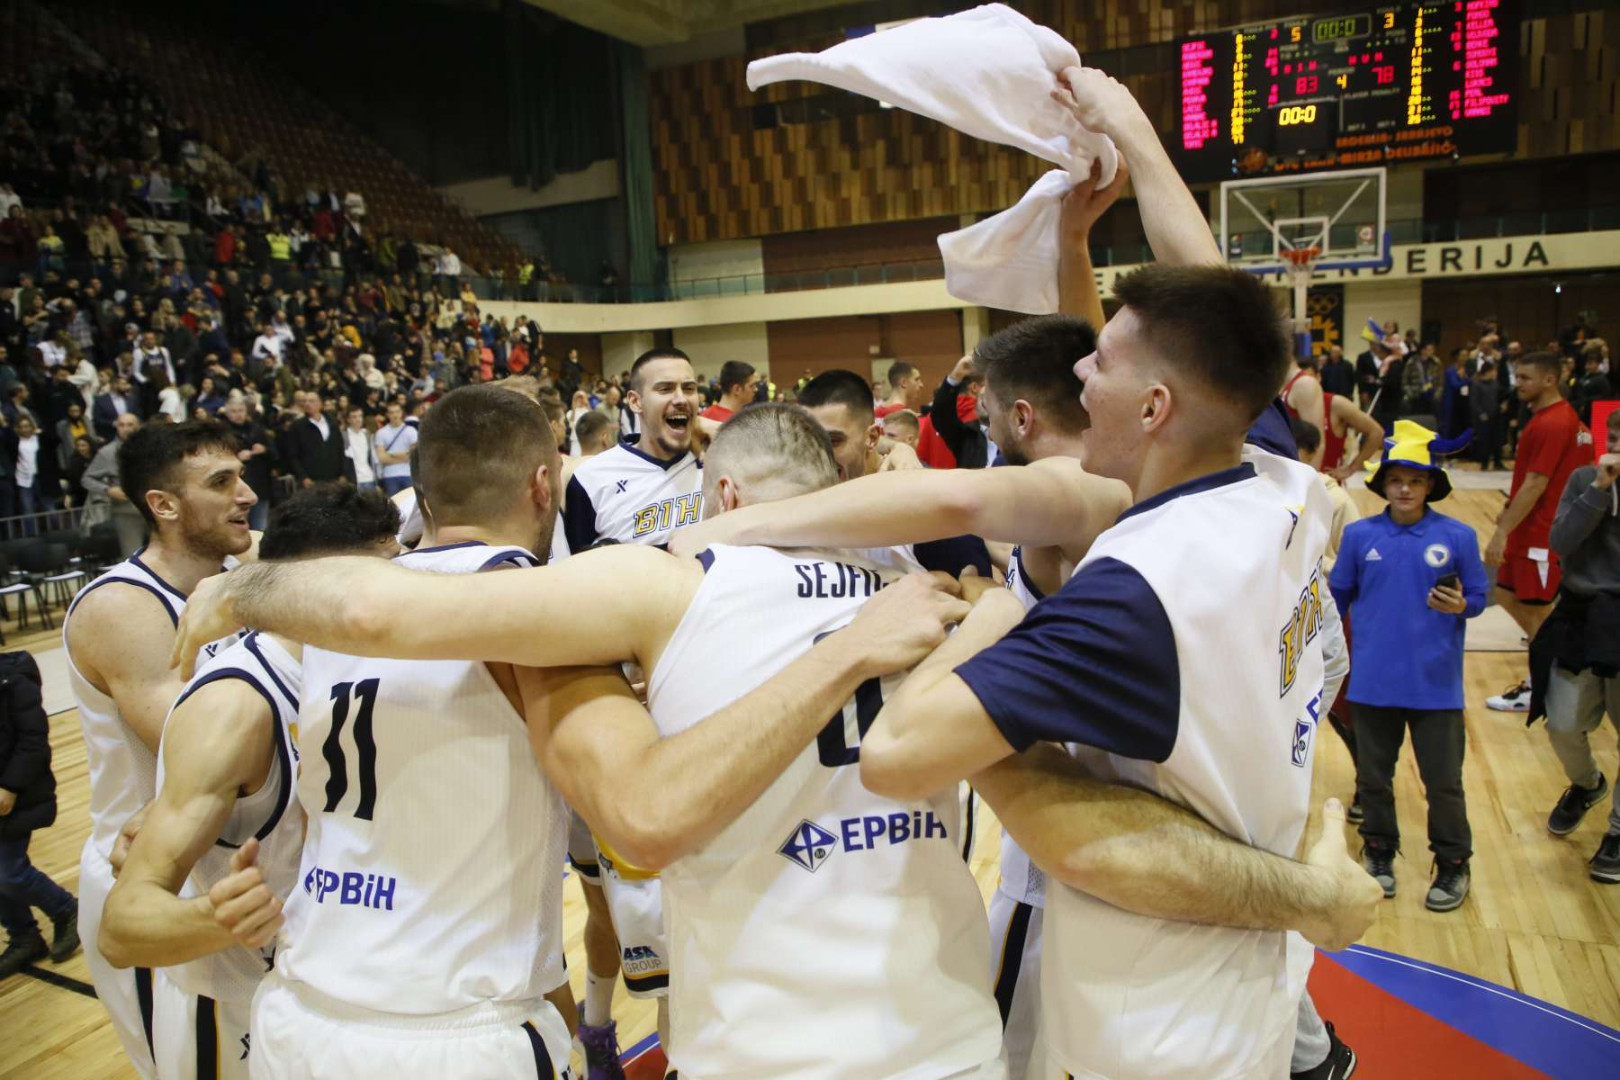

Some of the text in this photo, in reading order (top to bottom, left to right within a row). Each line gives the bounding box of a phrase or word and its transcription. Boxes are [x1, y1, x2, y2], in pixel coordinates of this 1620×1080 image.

[1317, 18, 1355, 40] 00:0
[1383, 12, 1394, 28] 3
[1291, 26, 1301, 42] 5
[1336, 73, 1347, 89] 4
[1371, 65, 1394, 84] 78
[1296, 76, 1318, 94] 83
[1279, 105, 1316, 125] 00:0
[632, 491, 702, 538] BIH
[322, 678, 380, 821] 11
[840, 811, 948, 853] EPBiH
[624, 959, 662, 973] GROUP
